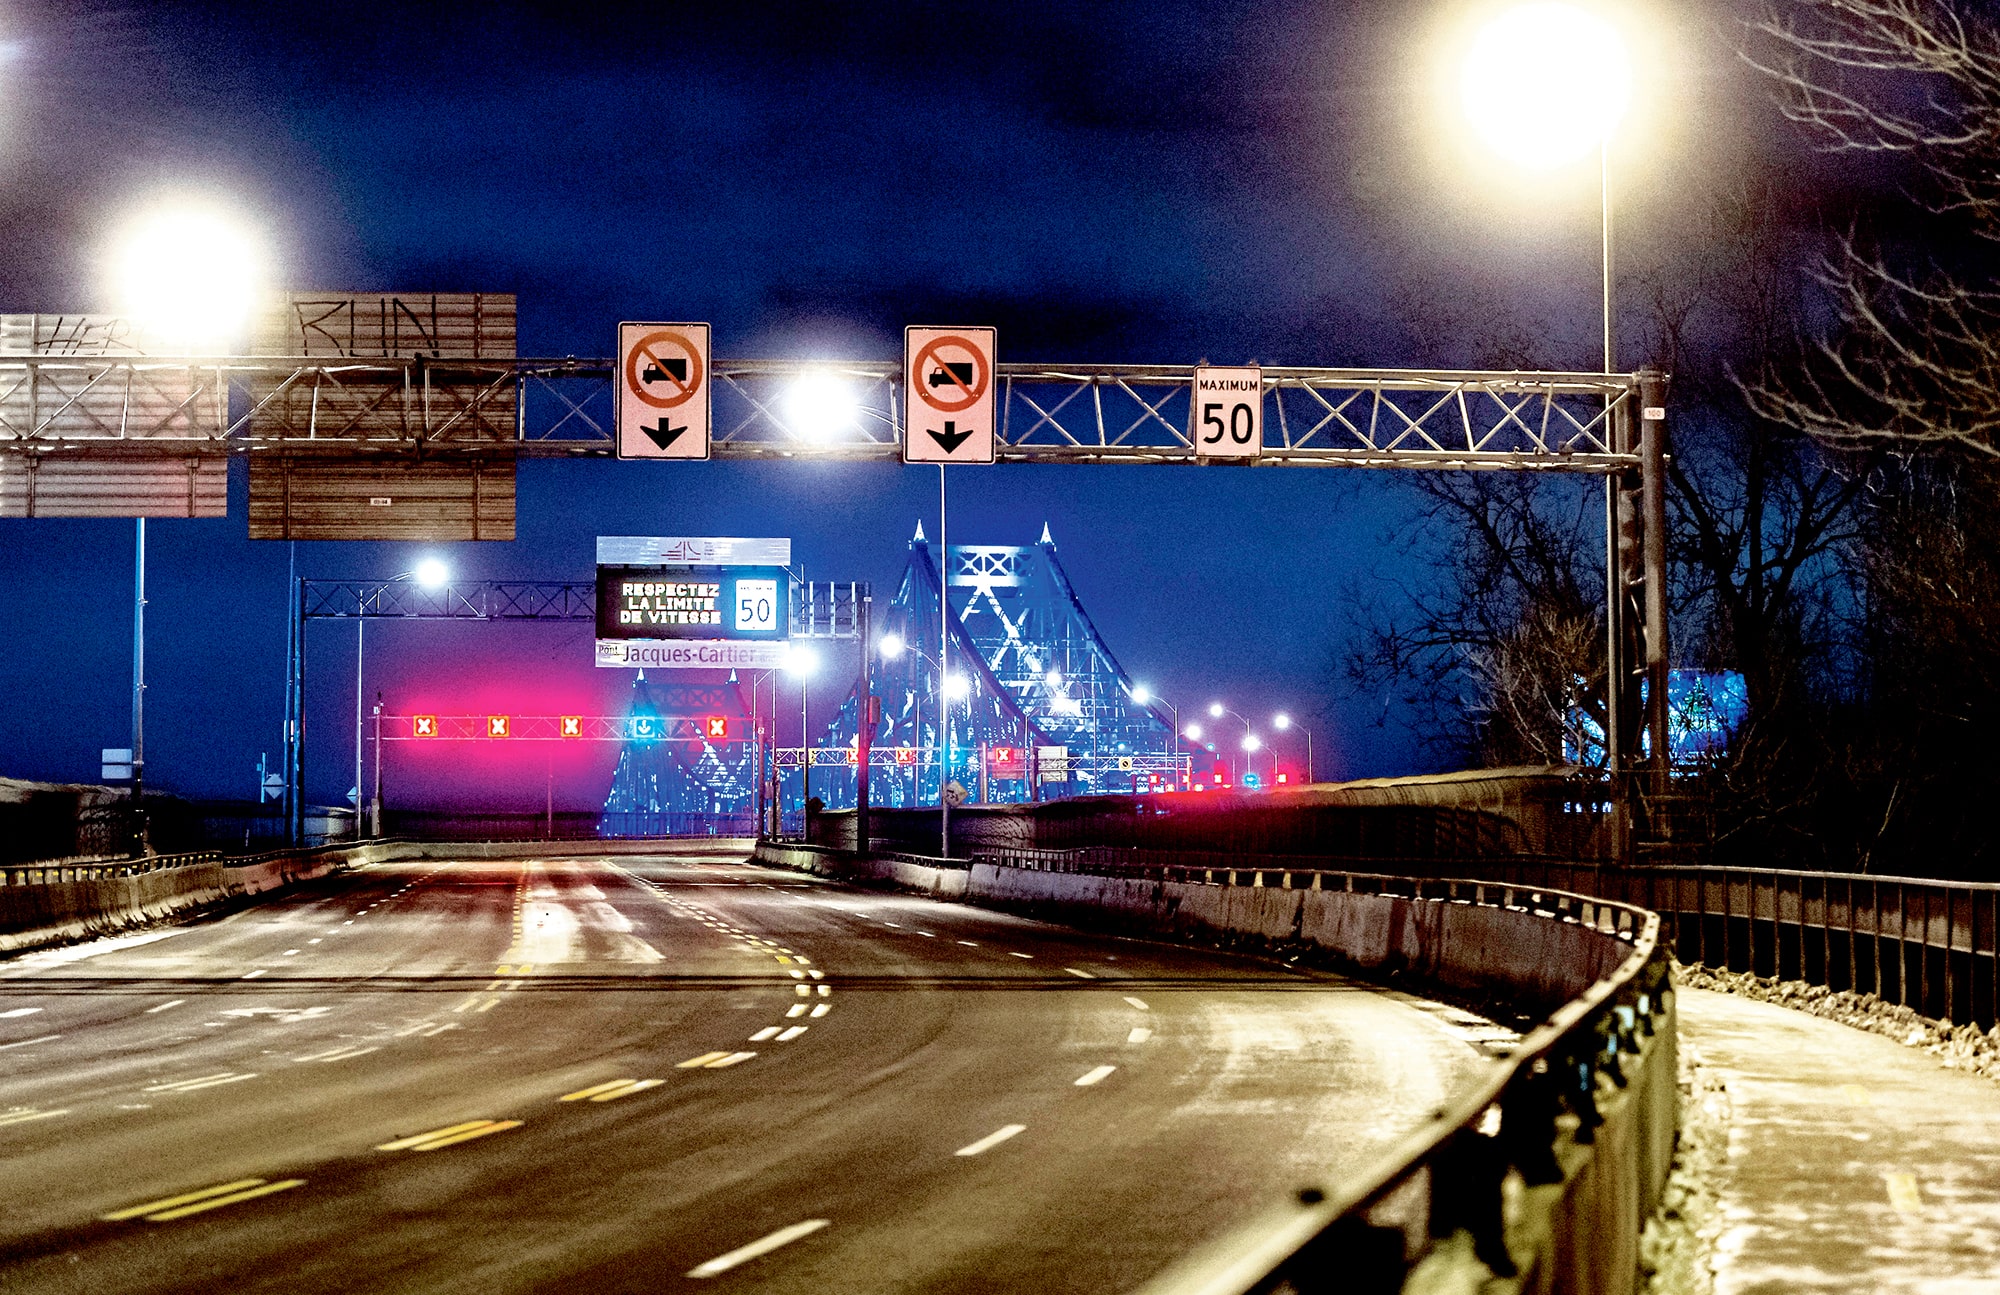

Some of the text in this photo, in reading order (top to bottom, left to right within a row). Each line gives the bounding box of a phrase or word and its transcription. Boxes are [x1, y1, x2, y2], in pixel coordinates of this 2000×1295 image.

[1200, 380, 1258, 391] MAXIMUM
[1203, 403, 1254, 444] 50
[622, 582, 720, 597] RESPECTEZ
[628, 597, 715, 611] LA LIMITE
[741, 598, 770, 622] 50
[620, 610, 721, 625] DE VITESSE
[623, 645, 755, 666] Jacques-Cartier
